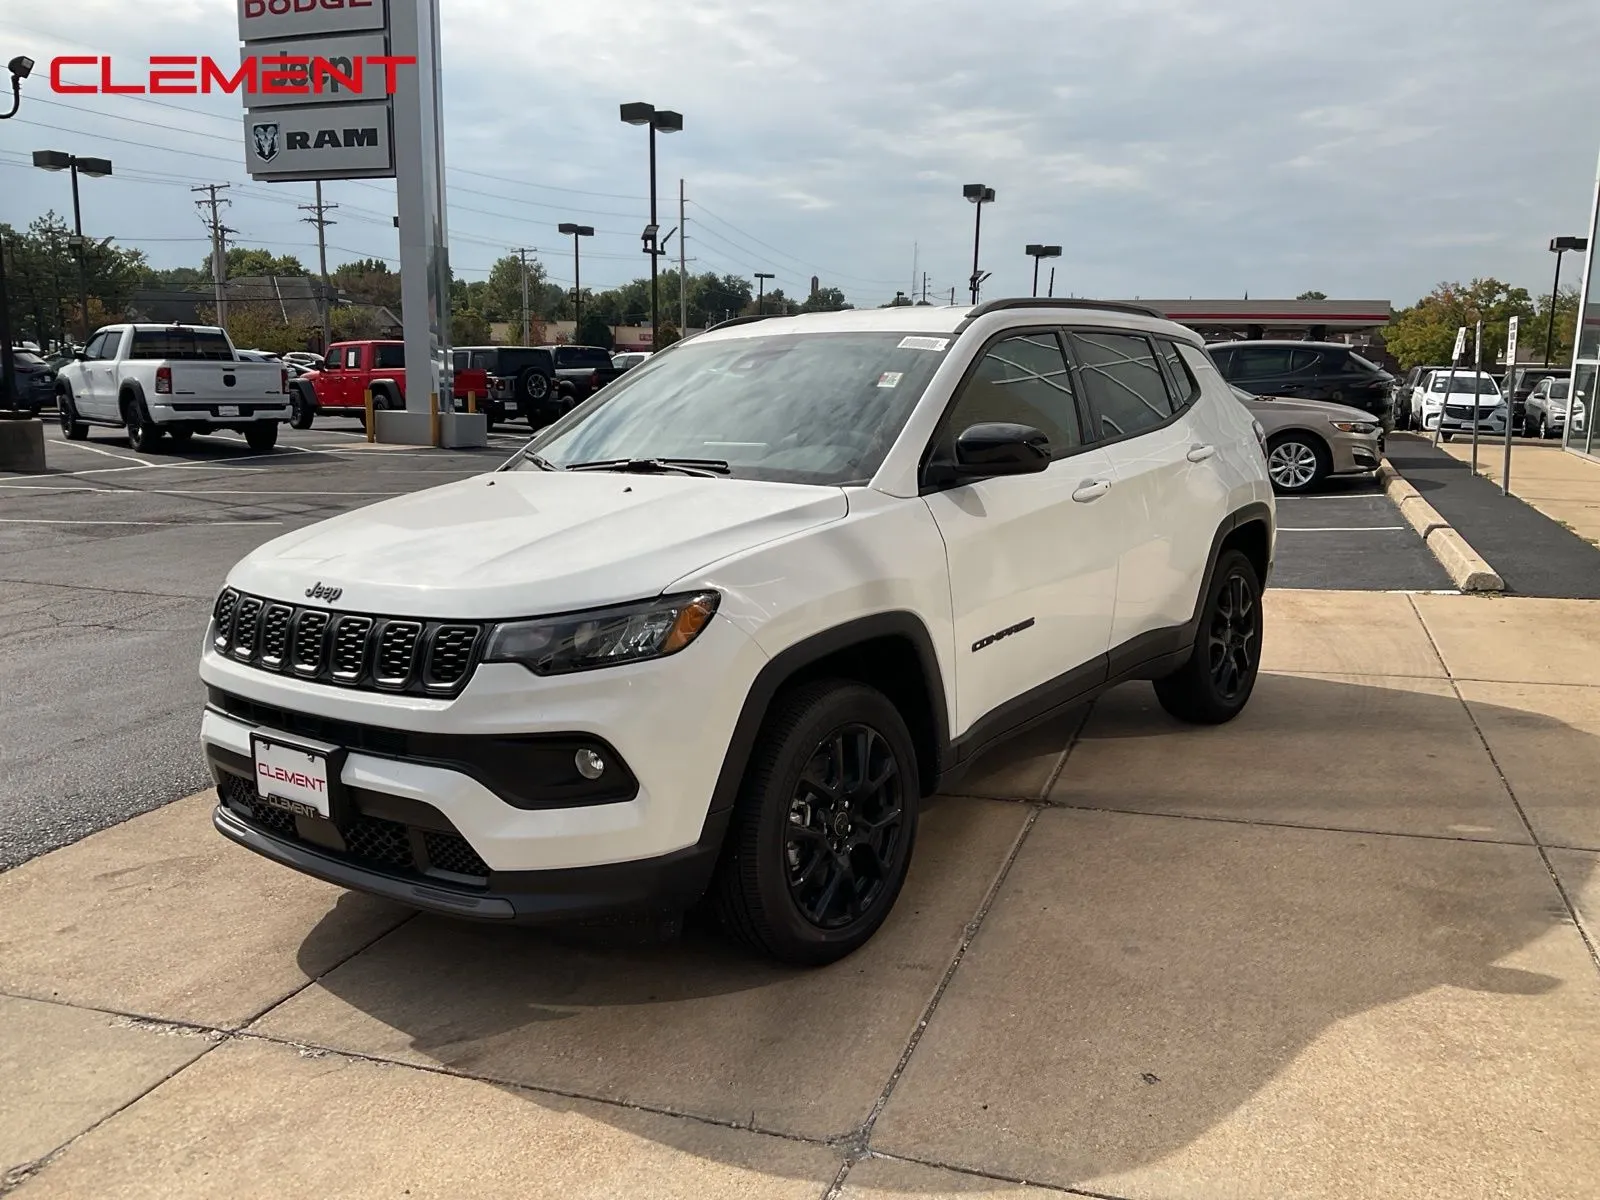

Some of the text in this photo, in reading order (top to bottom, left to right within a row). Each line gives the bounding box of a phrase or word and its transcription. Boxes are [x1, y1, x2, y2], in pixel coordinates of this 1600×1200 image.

[286, 128, 378, 150] RAM
[305, 581, 343, 604] Jeep
[258, 762, 326, 793] CLEMENT
[268, 795, 315, 818] CLEMENT
